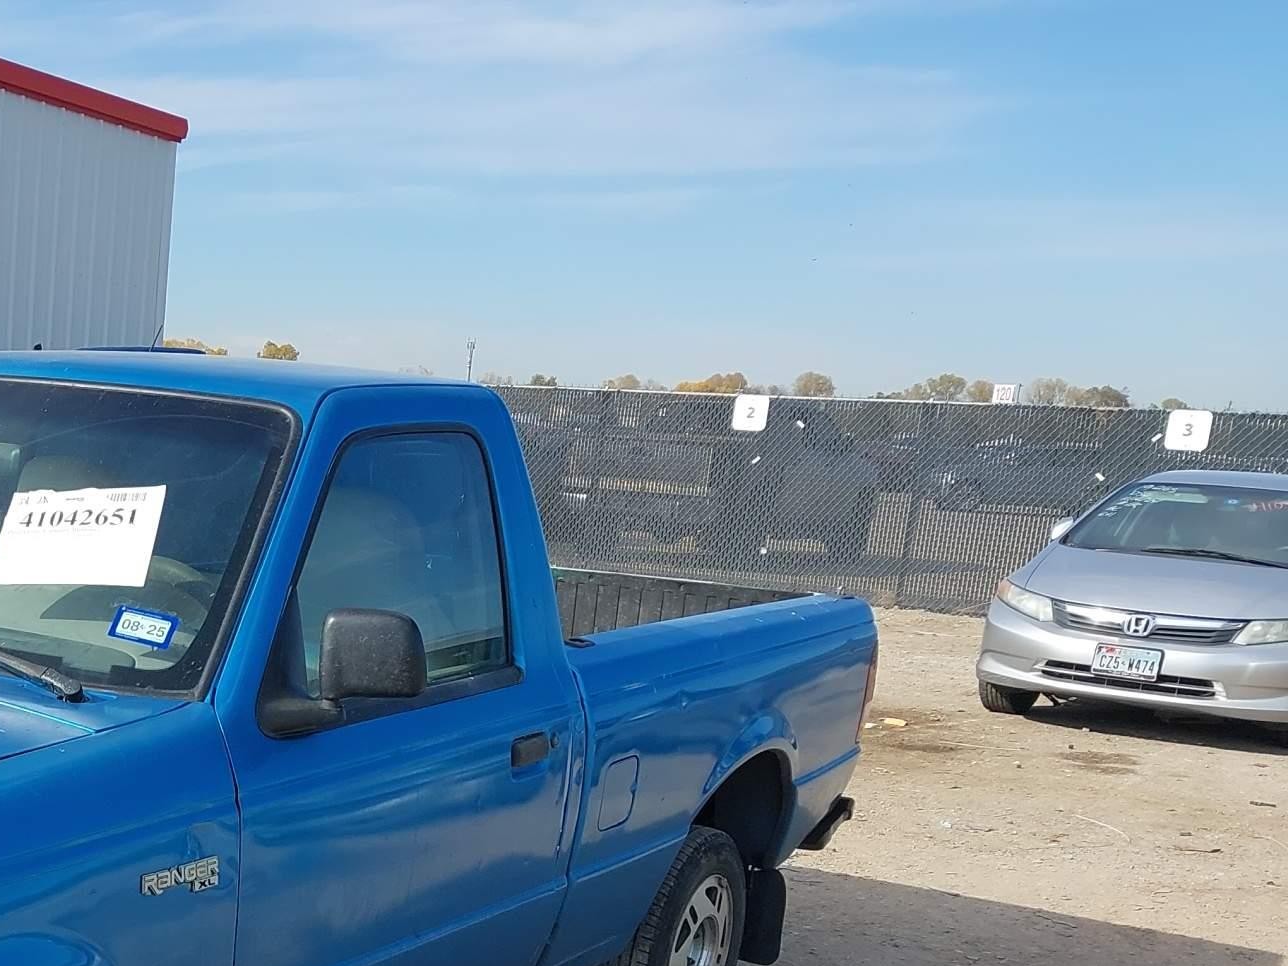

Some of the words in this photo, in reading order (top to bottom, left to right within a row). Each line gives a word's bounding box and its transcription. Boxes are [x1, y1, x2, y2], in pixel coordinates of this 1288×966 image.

[996, 386, 1012, 401] 120
[746, 407, 756, 419] 2
[1182, 423, 1193, 437] 3
[19, 508, 137, 528] 41042651
[121, 618, 141, 632] 08
[146, 624, 167, 638] 25
[142, 856, 219, 896] RANGER
